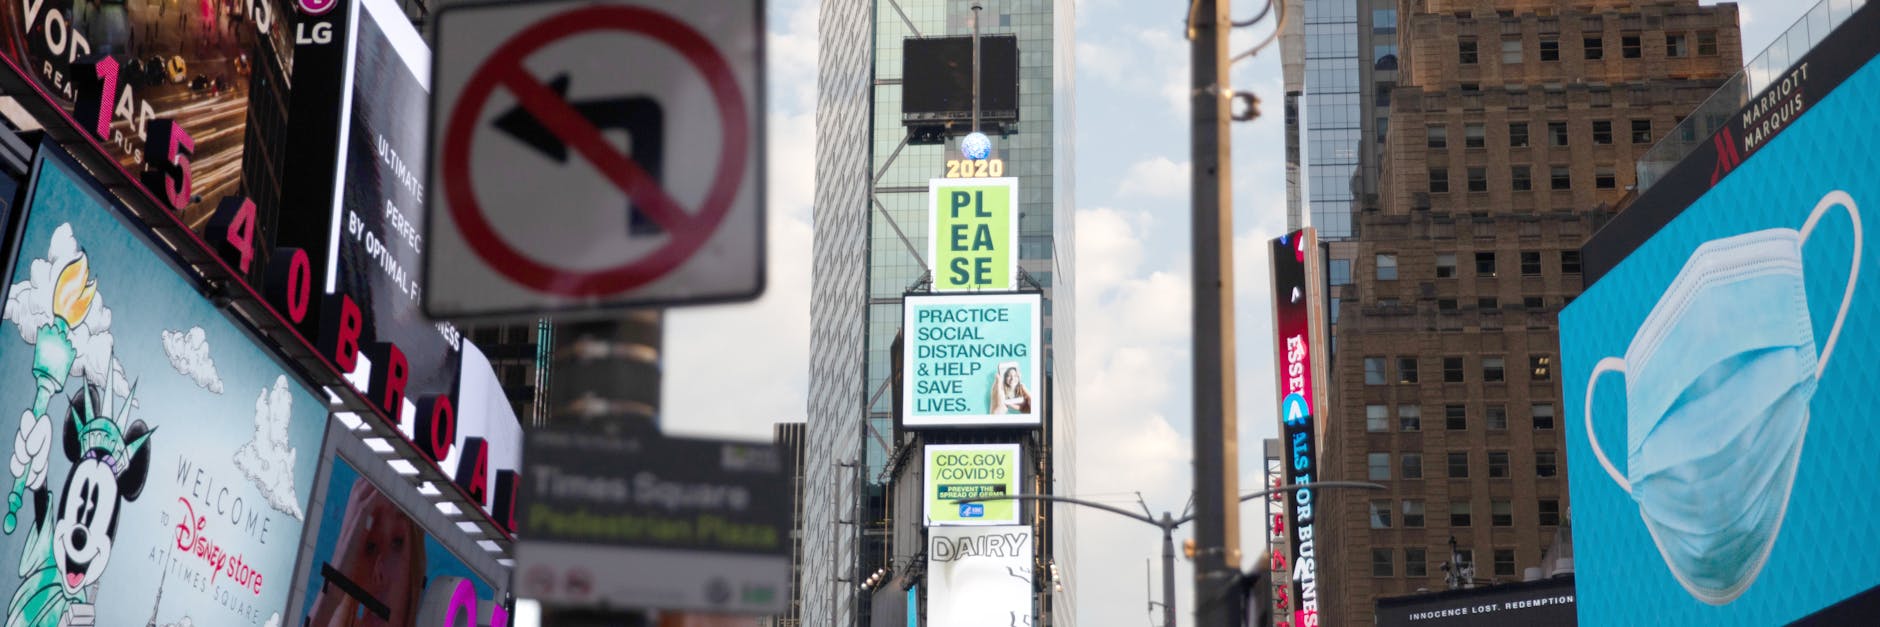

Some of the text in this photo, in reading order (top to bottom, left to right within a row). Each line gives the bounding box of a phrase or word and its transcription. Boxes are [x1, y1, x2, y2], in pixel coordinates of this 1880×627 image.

[296, 21, 333, 45] LG
[43, 60, 79, 103] REA
[1742, 62, 1809, 129] MARRIOTT
[1743, 93, 1804, 152] MARQUIS
[378, 133, 424, 204] ULTIMATE
[946, 158, 1004, 178] 2020
[96, 55, 312, 325] 1540
[386, 199, 422, 255] PERFEC
[349, 210, 366, 242] BY
[366, 231, 409, 294] OPTIMAL
[918, 308, 1009, 324] PRACTICE
[918, 326, 985, 341] SOCIAL
[917, 343, 1027, 359] DISTANCING
[916, 362, 982, 377] & HELP
[916, 379, 963, 395] SAVE
[916, 397, 971, 413] LIVES.
[935, 468, 1005, 480] /COVID19
[936, 454, 1006, 467] CDC.GOV
[176, 454, 271, 545] WELCOME
[1295, 474, 1312, 523] FOR
[931, 532, 1028, 562] DAIRY
[148, 546, 261, 625] AT TIMES SQUARE
[226, 552, 263, 595] store
[1409, 595, 1574, 621] INNOCENCE LOST. REDEMPTION
